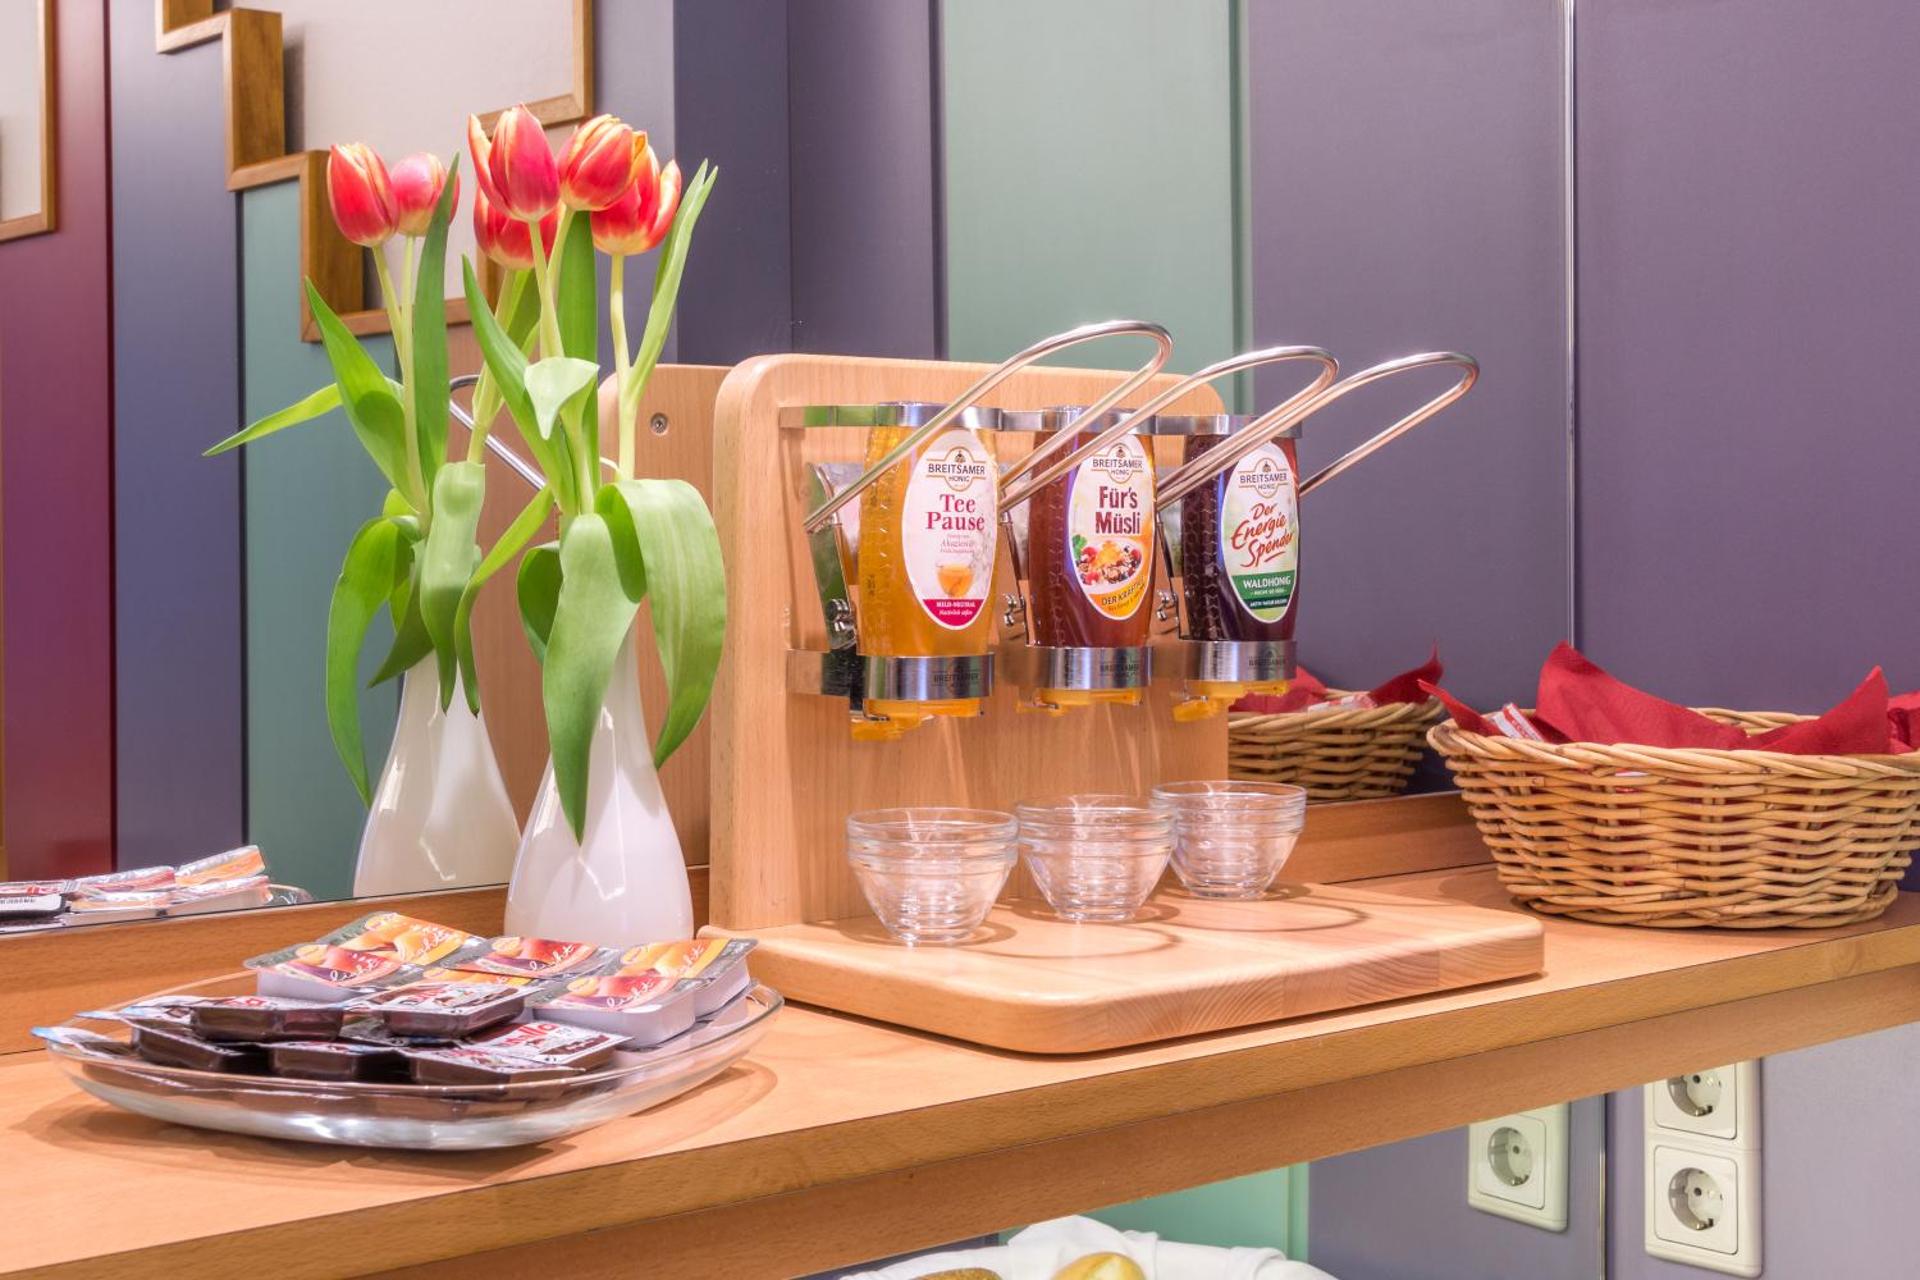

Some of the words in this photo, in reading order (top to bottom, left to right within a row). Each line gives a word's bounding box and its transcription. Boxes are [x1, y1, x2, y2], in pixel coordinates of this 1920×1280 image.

[928, 463, 985, 475] BREITSAMER
[1092, 458, 1143, 469] BREITSAMER
[1239, 472, 1288, 484] BREITSAMER
[939, 493, 976, 513] Tee
[1099, 486, 1138, 509] Für's
[1251, 503, 1278, 520] Der
[925, 511, 985, 531] Pause
[1095, 512, 1140, 535] Müsli
[1231, 513, 1286, 550] Energie
[1243, 575, 1291, 589] WALDHONIG
